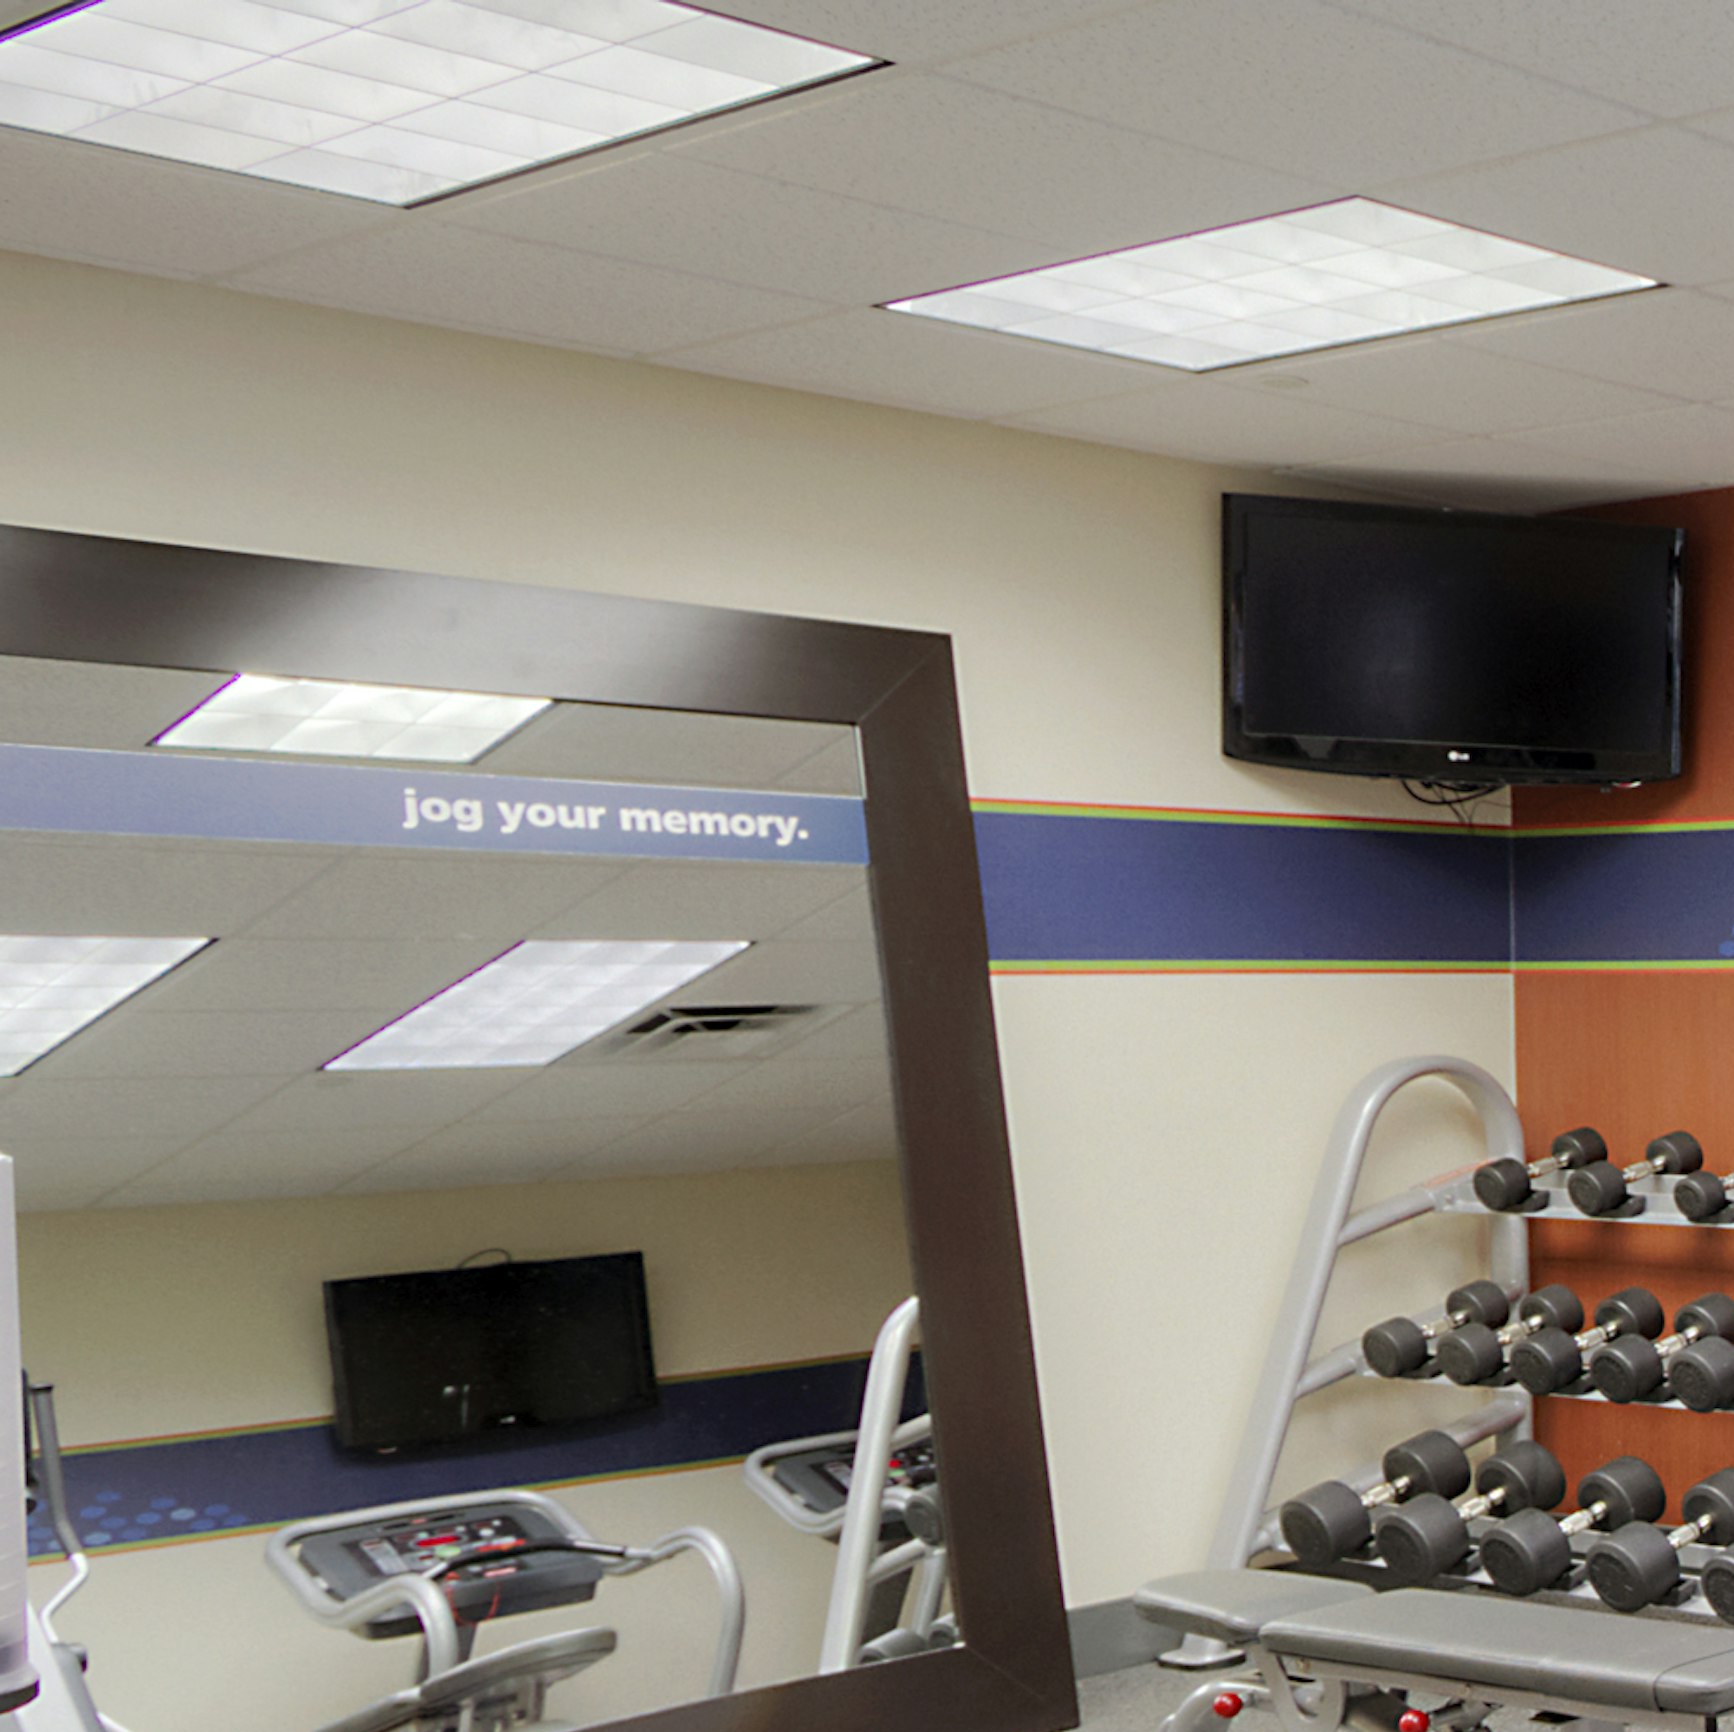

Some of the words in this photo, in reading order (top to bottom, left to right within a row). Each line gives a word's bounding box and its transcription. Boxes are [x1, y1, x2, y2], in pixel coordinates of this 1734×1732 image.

[403, 788, 483, 830] jog
[498, 802, 606, 834] your
[620, 807, 809, 846] memory.
